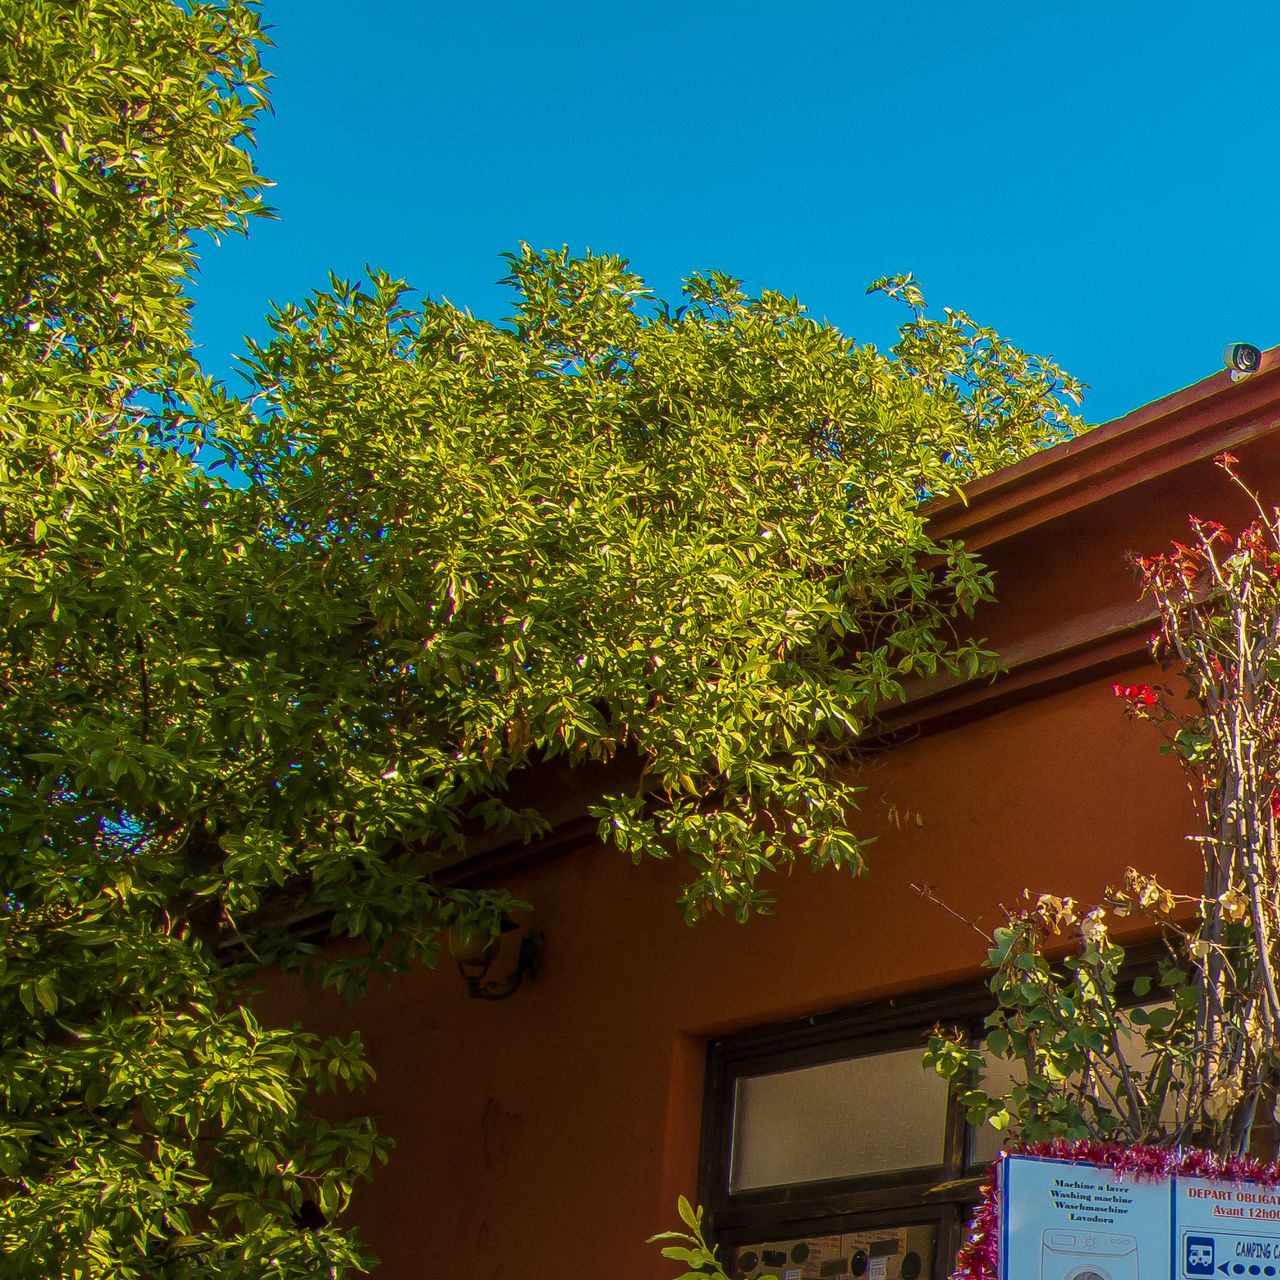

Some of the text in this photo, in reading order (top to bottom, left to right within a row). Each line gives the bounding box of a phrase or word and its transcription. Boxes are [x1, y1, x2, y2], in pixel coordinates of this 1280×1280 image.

[1054, 1179, 1095, 1190] Machine
[1050, 1190, 1133, 1204] Washing machine
[1188, 1188, 1232, 1201] DEPART
[1054, 1201, 1129, 1214] Waschmaschine
[1214, 1205, 1244, 1216] Avant
[1069, 1214, 1114, 1224] Lavadora
[1236, 1241, 1270, 1259] CAMPING
